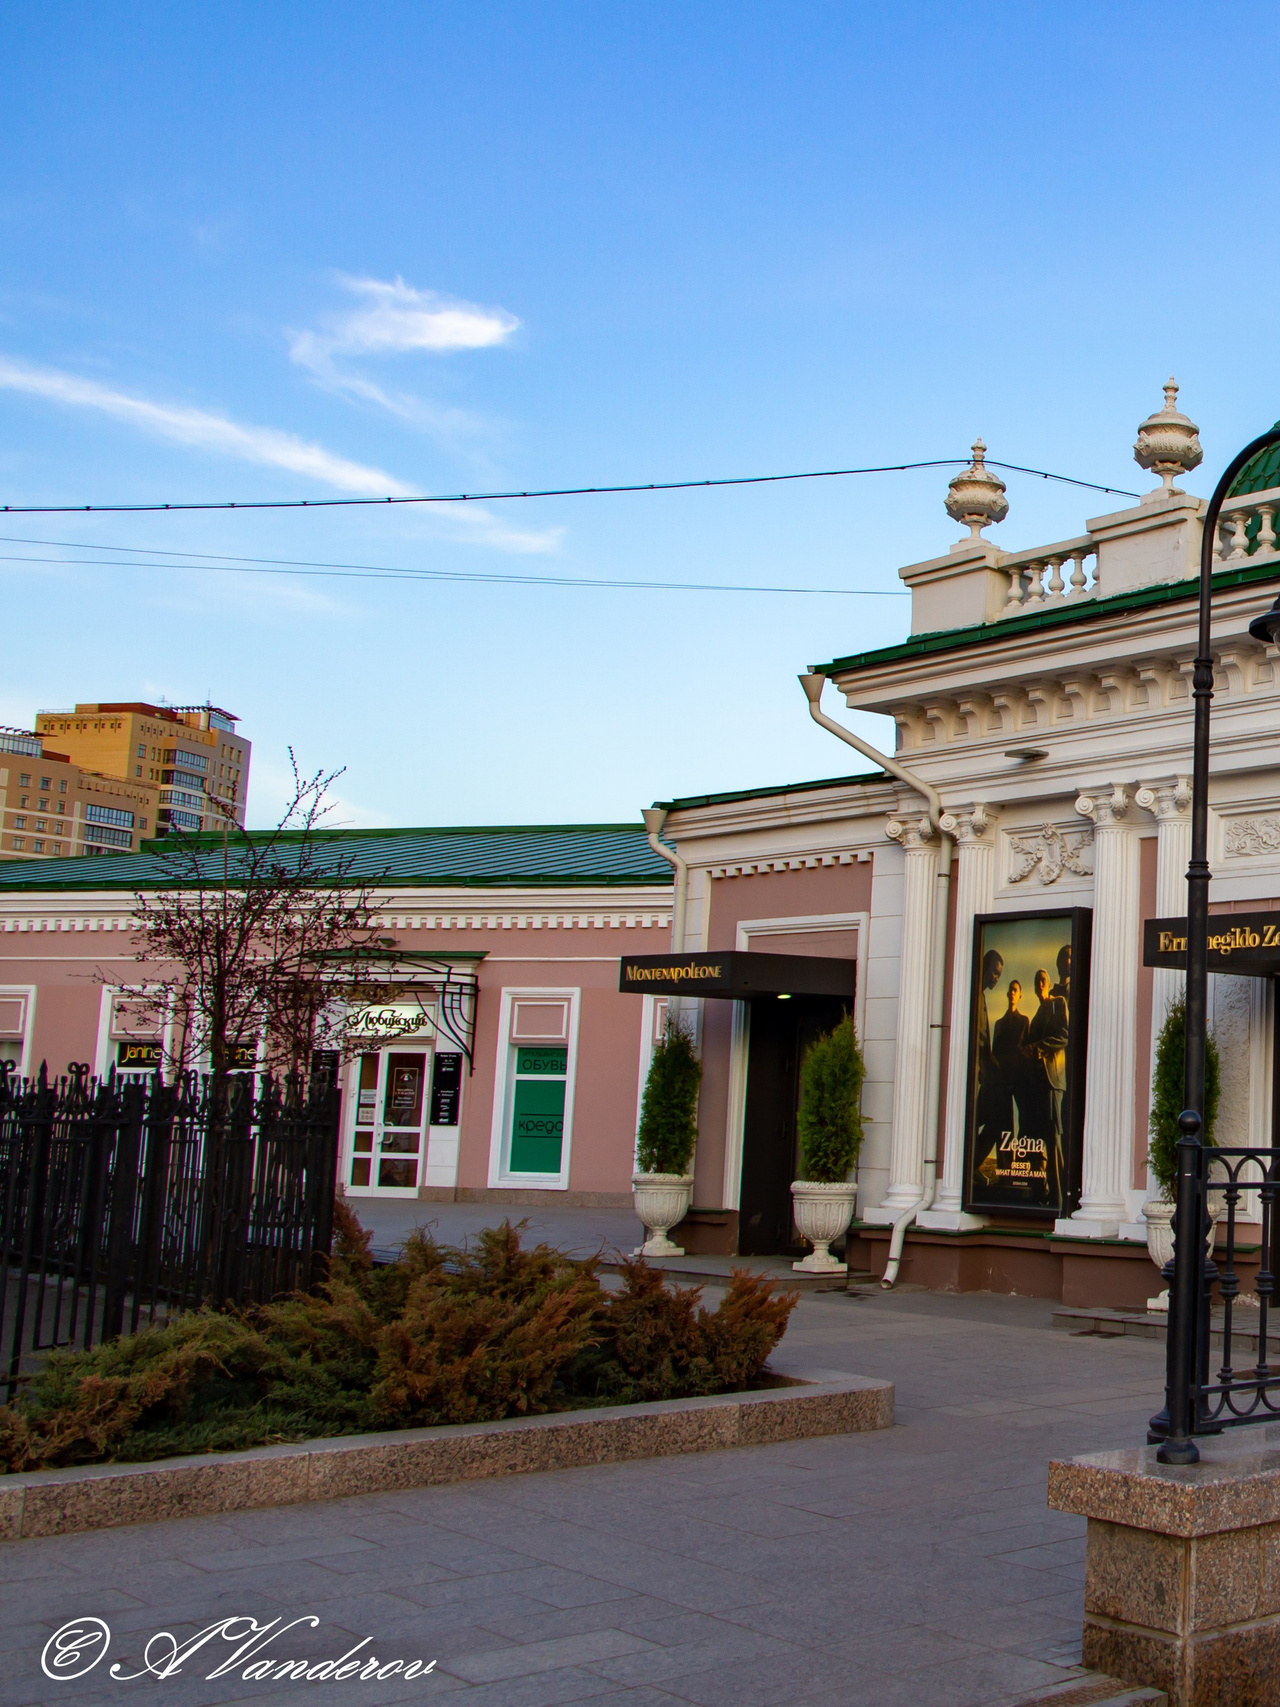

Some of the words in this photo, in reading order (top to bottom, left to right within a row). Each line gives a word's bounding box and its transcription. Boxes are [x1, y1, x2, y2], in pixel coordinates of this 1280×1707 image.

[121, 1044, 162, 1063] Janine
[522, 1059, 566, 1071] ОБУВЬ
[999, 1131, 1045, 1157] Zegna
